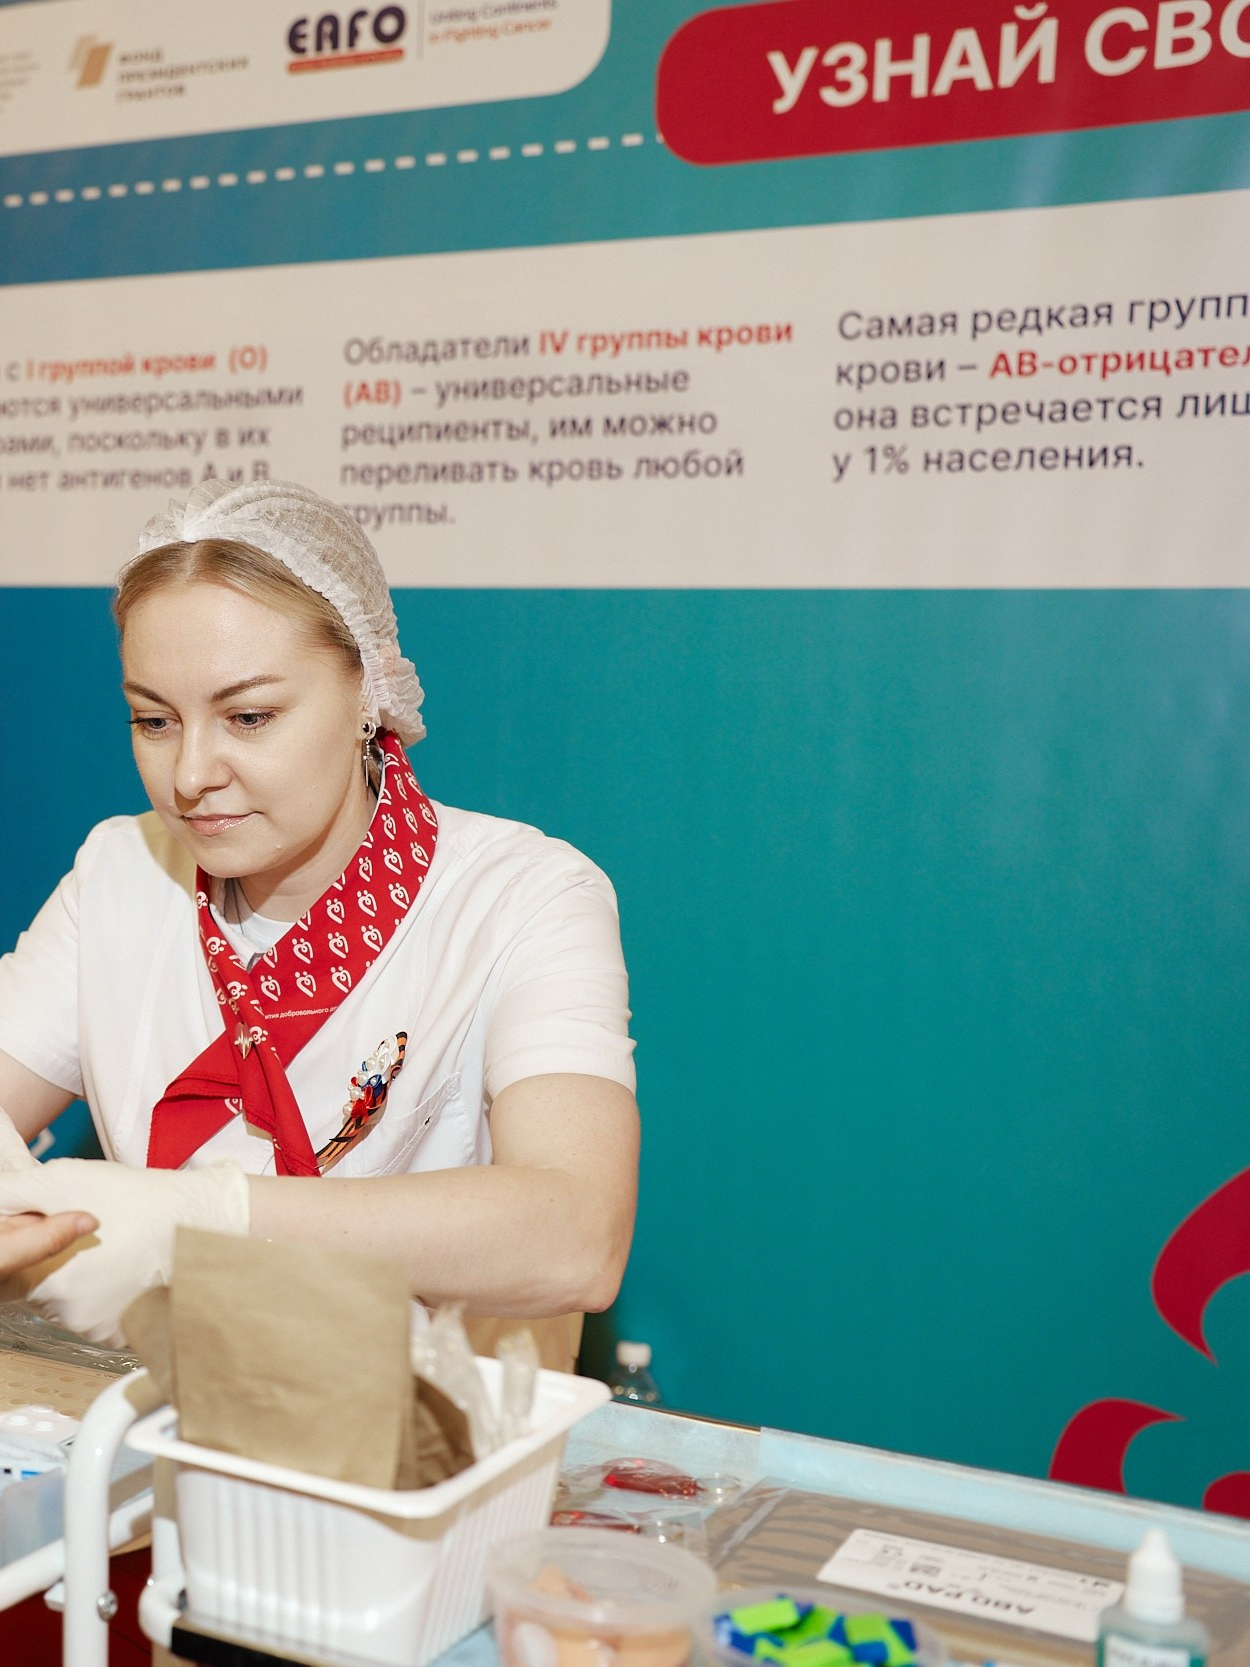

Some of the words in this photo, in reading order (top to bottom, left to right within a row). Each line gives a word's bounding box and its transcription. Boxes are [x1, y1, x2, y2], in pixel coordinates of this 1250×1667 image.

[287, 6, 407, 54] EAFO
[766, 2, 1059, 115] УЗНАЙ
[838, 310, 958, 342] Самая
[970, 302, 1113, 339] редкая
[1128, 293, 1250, 331] групп
[343, 334, 530, 366] Обладатели
[539, 330, 569, 355] IV
[577, 328, 688, 359] группы
[697, 321, 794, 352] крови
[6, 364, 21, 382] с
[38, 352, 135, 387] группой
[141, 350, 216, 380] крови
[435, 368, 690, 408] универсальные
[835, 358, 946, 392] крови
[67, 386, 304, 420] универсальными
[834, 406, 898, 432] она
[911, 393, 1162, 434] встречается
[67, 429, 207, 457] поскольку
[215, 427, 231, 449] в
[238, 426, 272, 448] их
[341, 420, 538, 451] реципиенты,
[549, 414, 592, 439] им
[603, 410, 718, 437] можно
[8, 469, 50, 490] нет
[57, 464, 193, 491] антигенов
[340, 459, 518, 489] переливать
[529, 456, 623, 488] кровь
[633, 448, 745, 478] любой
[832, 451, 852, 484] у
[863, 444, 910, 475] 1%
[923, 442, 1145, 474] населения.
